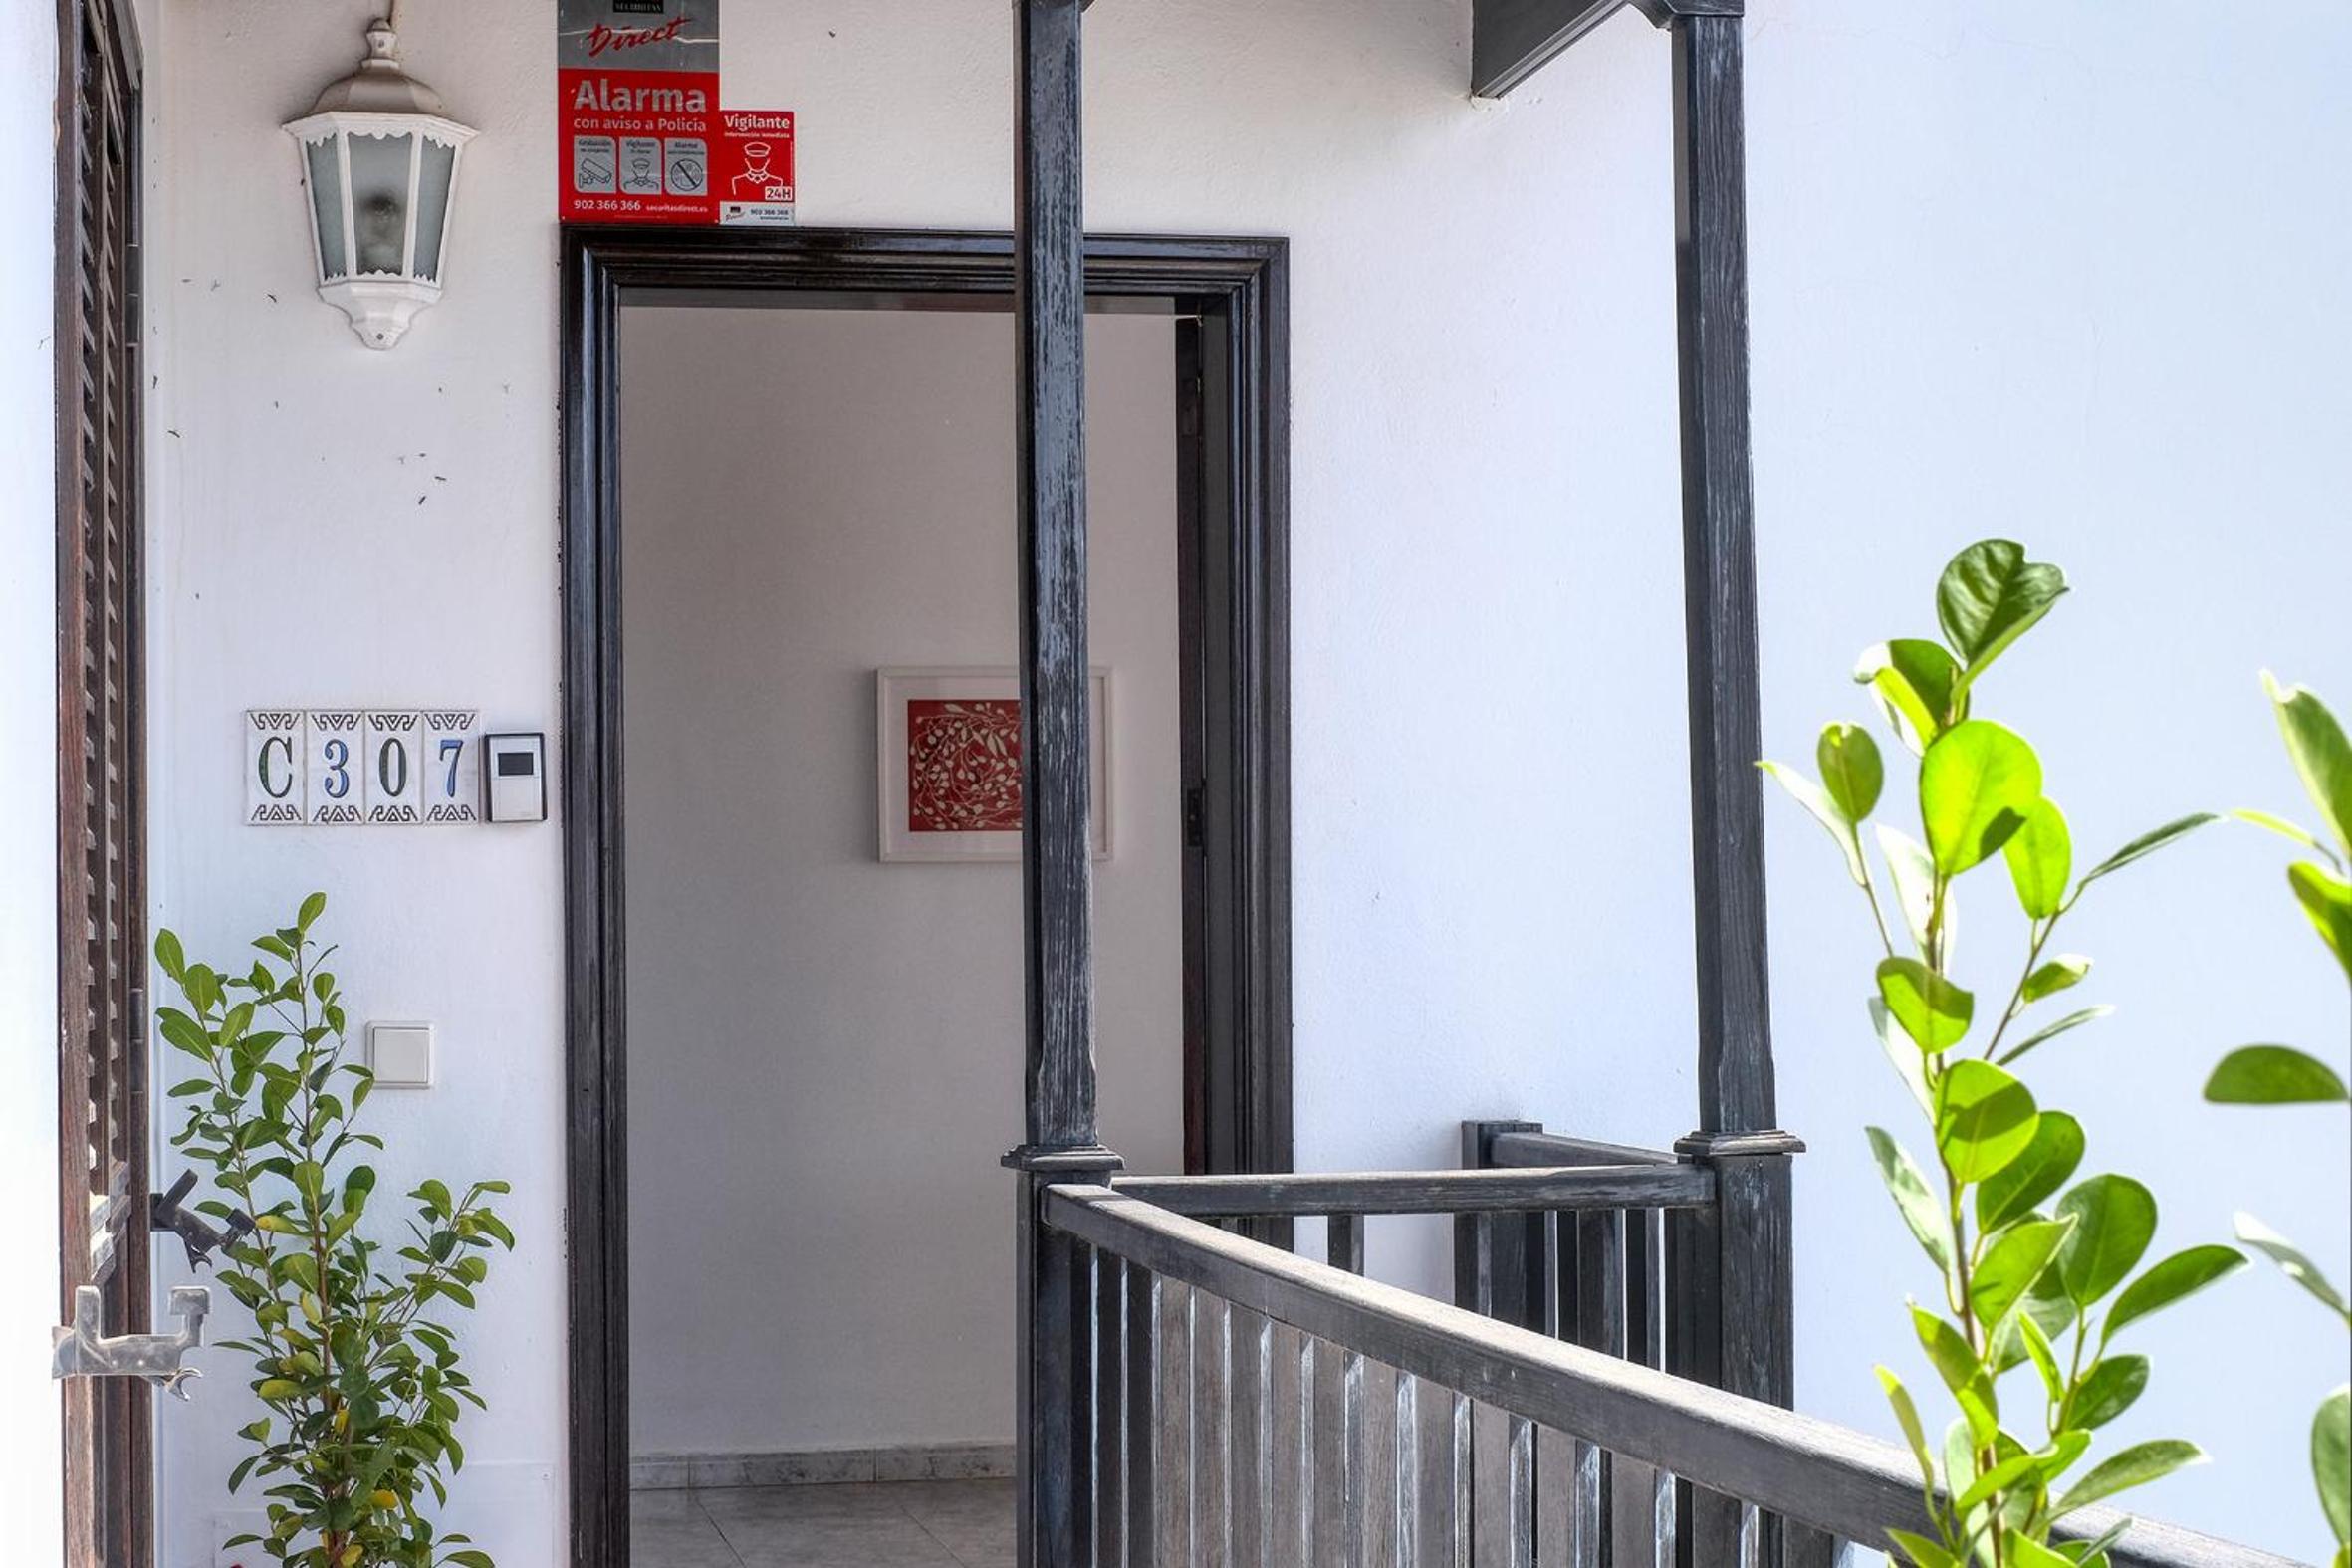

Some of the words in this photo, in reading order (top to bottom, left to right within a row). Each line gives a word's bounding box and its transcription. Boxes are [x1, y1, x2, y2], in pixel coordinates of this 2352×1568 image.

[588, 16, 691, 56] Direct
[574, 79, 706, 113] Alarma
[574, 118, 599, 129] con
[603, 116, 641, 130] aviso
[645, 120, 653, 131] a
[724, 113, 790, 131] Vigilante
[767, 188, 790, 199] 24H
[574, 199, 594, 210] 902
[597, 200, 617, 211] 366
[620, 200, 641, 211] 366
